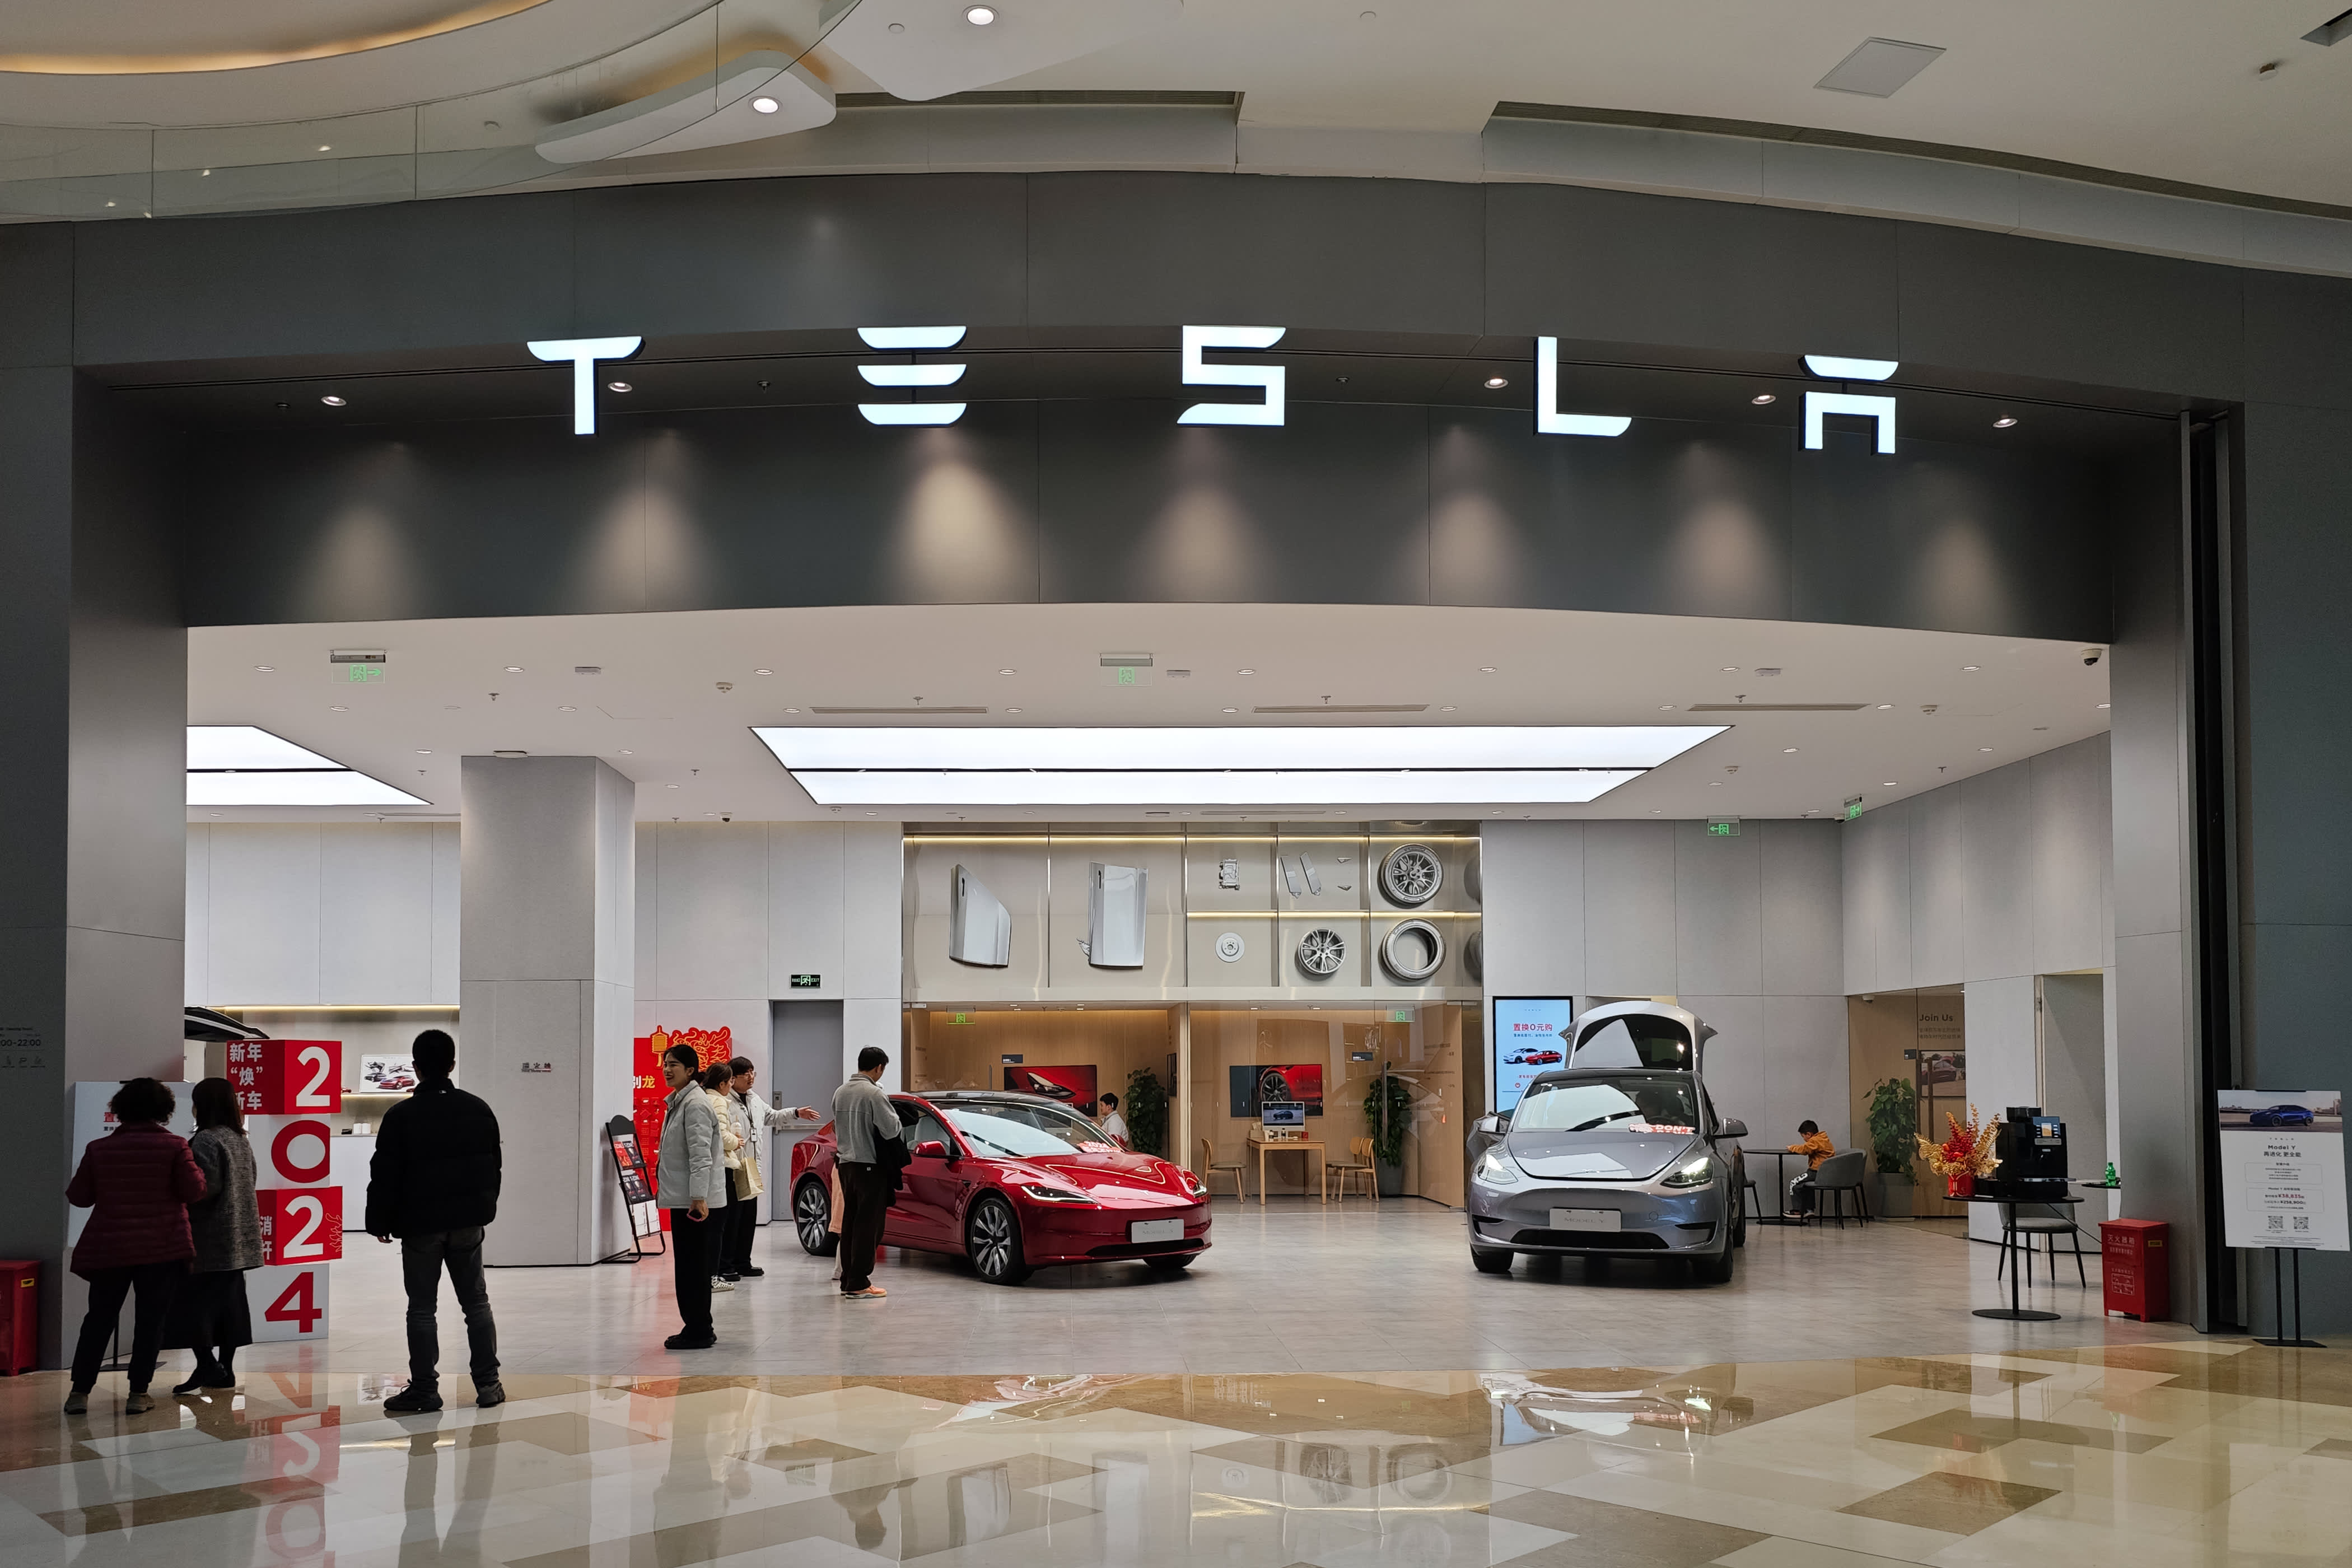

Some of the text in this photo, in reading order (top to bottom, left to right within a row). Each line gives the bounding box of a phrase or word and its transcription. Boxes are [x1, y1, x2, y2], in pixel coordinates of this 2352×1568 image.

[527, 325, 1899, 454] TESLA
[230, 1043, 263, 1062] 新年
[296, 1046, 330, 1107] 2
[283, 1195, 324, 1259] 2
[264, 1271, 323, 1333] 4
